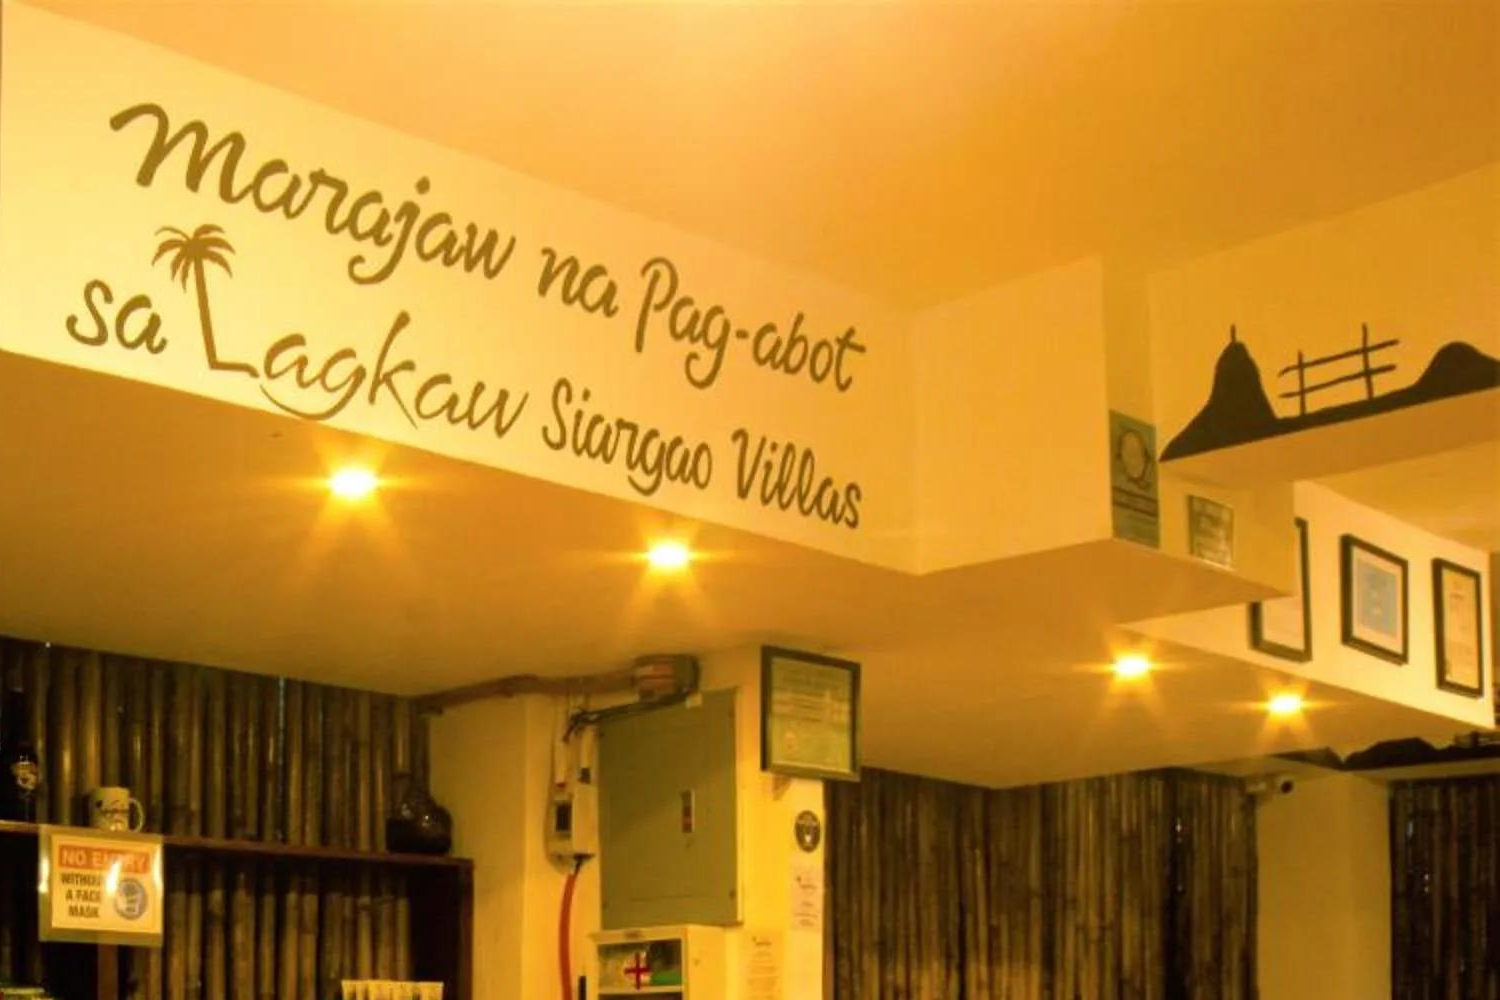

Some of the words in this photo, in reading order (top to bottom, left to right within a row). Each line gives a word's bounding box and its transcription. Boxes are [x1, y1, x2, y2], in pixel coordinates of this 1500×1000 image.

[109, 102, 517, 286] Marajaw
[538, 247, 619, 319] na
[634, 256, 867, 393] Pag-abot
[66, 278, 169, 355] sa
[151, 223, 530, 441] Lagkaw
[541, 377, 714, 497] Siargao
[731, 427, 863, 530] Villas
[61, 850, 87, 866] NO
[61, 873, 103, 887] WITHOU
